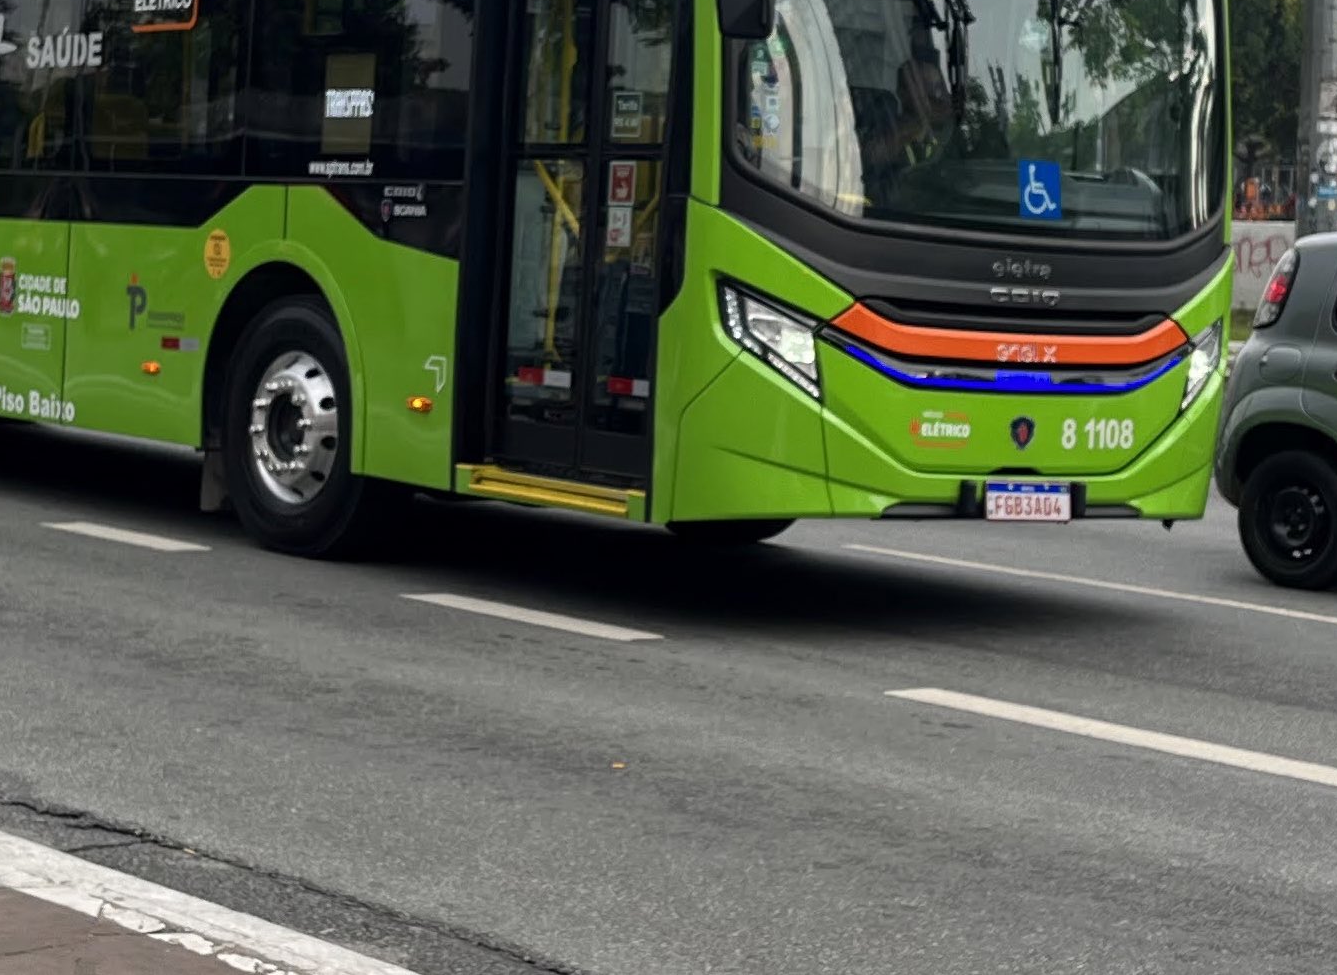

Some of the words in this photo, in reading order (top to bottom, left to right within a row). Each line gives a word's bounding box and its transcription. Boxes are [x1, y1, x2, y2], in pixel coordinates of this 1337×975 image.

[26, 27, 103, 69] SAÚDE
[18, 274, 52, 293] CIDADE
[52, 276, 67, 295] DE
[17, 293, 41, 315] SÃO
[42, 297, 81, 319] PAULO
[29, 389, 76, 422] Baixo
[921, 421, 971, 439] ELÉTRICO
[1062, 418, 1078, 450] 8
[1084, 417, 1135, 450] 1108
